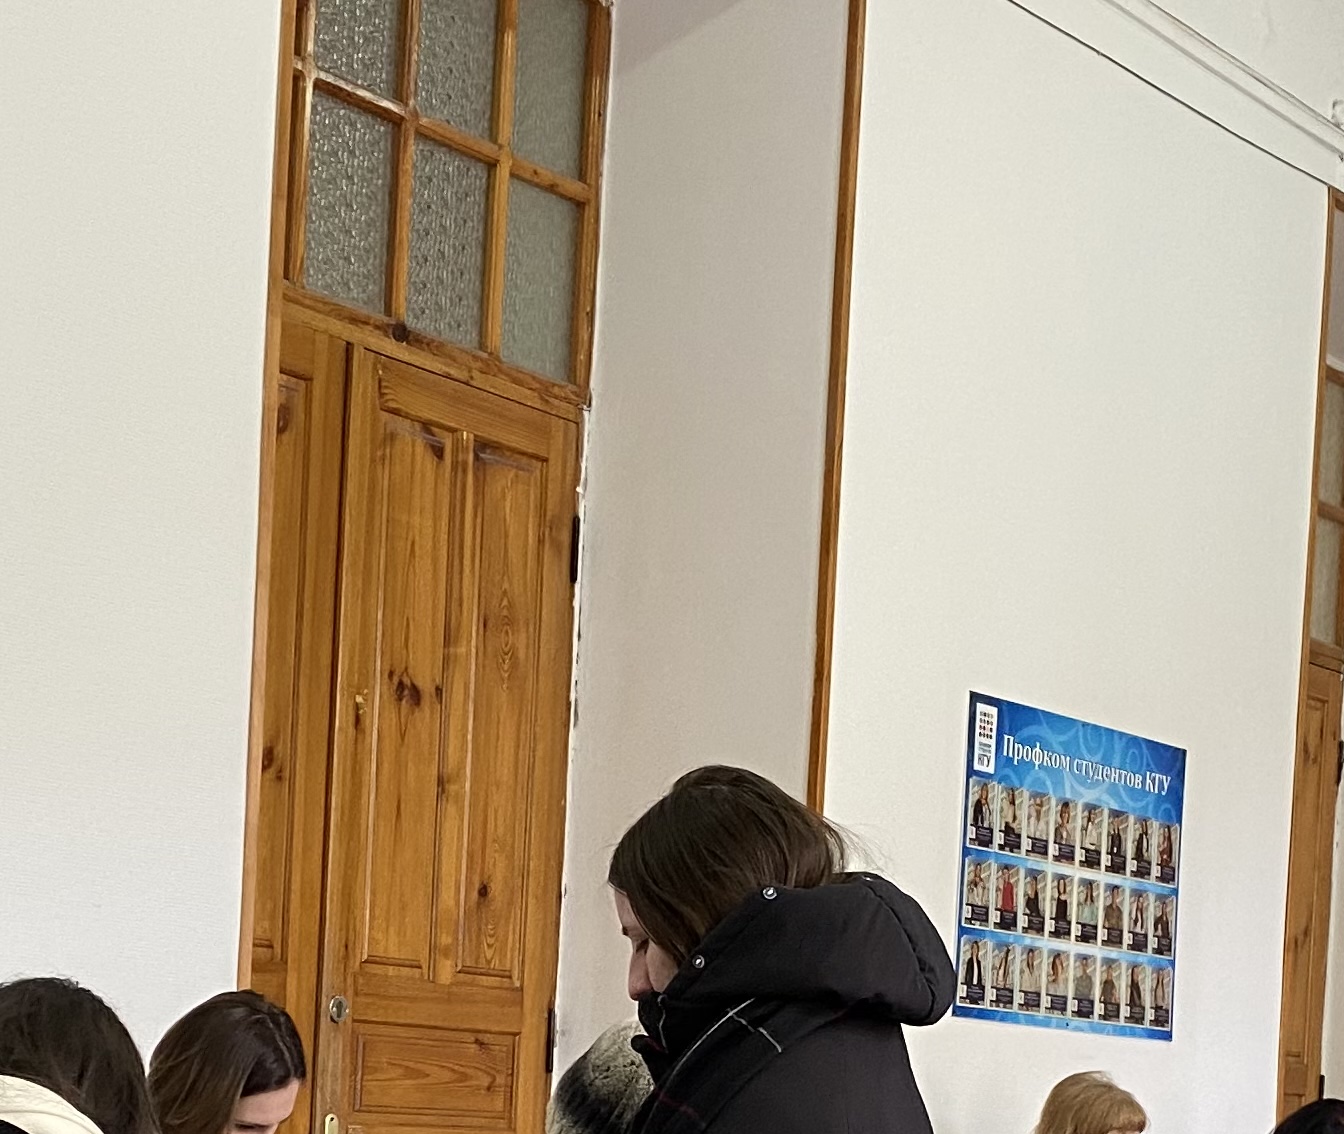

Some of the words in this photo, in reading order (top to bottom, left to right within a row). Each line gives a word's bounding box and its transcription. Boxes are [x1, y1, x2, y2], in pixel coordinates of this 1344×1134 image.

[1003, 734, 1070, 772] Профком
[1073, 757, 1142, 789] студентов
[1145, 771, 1172, 796] КГУ
